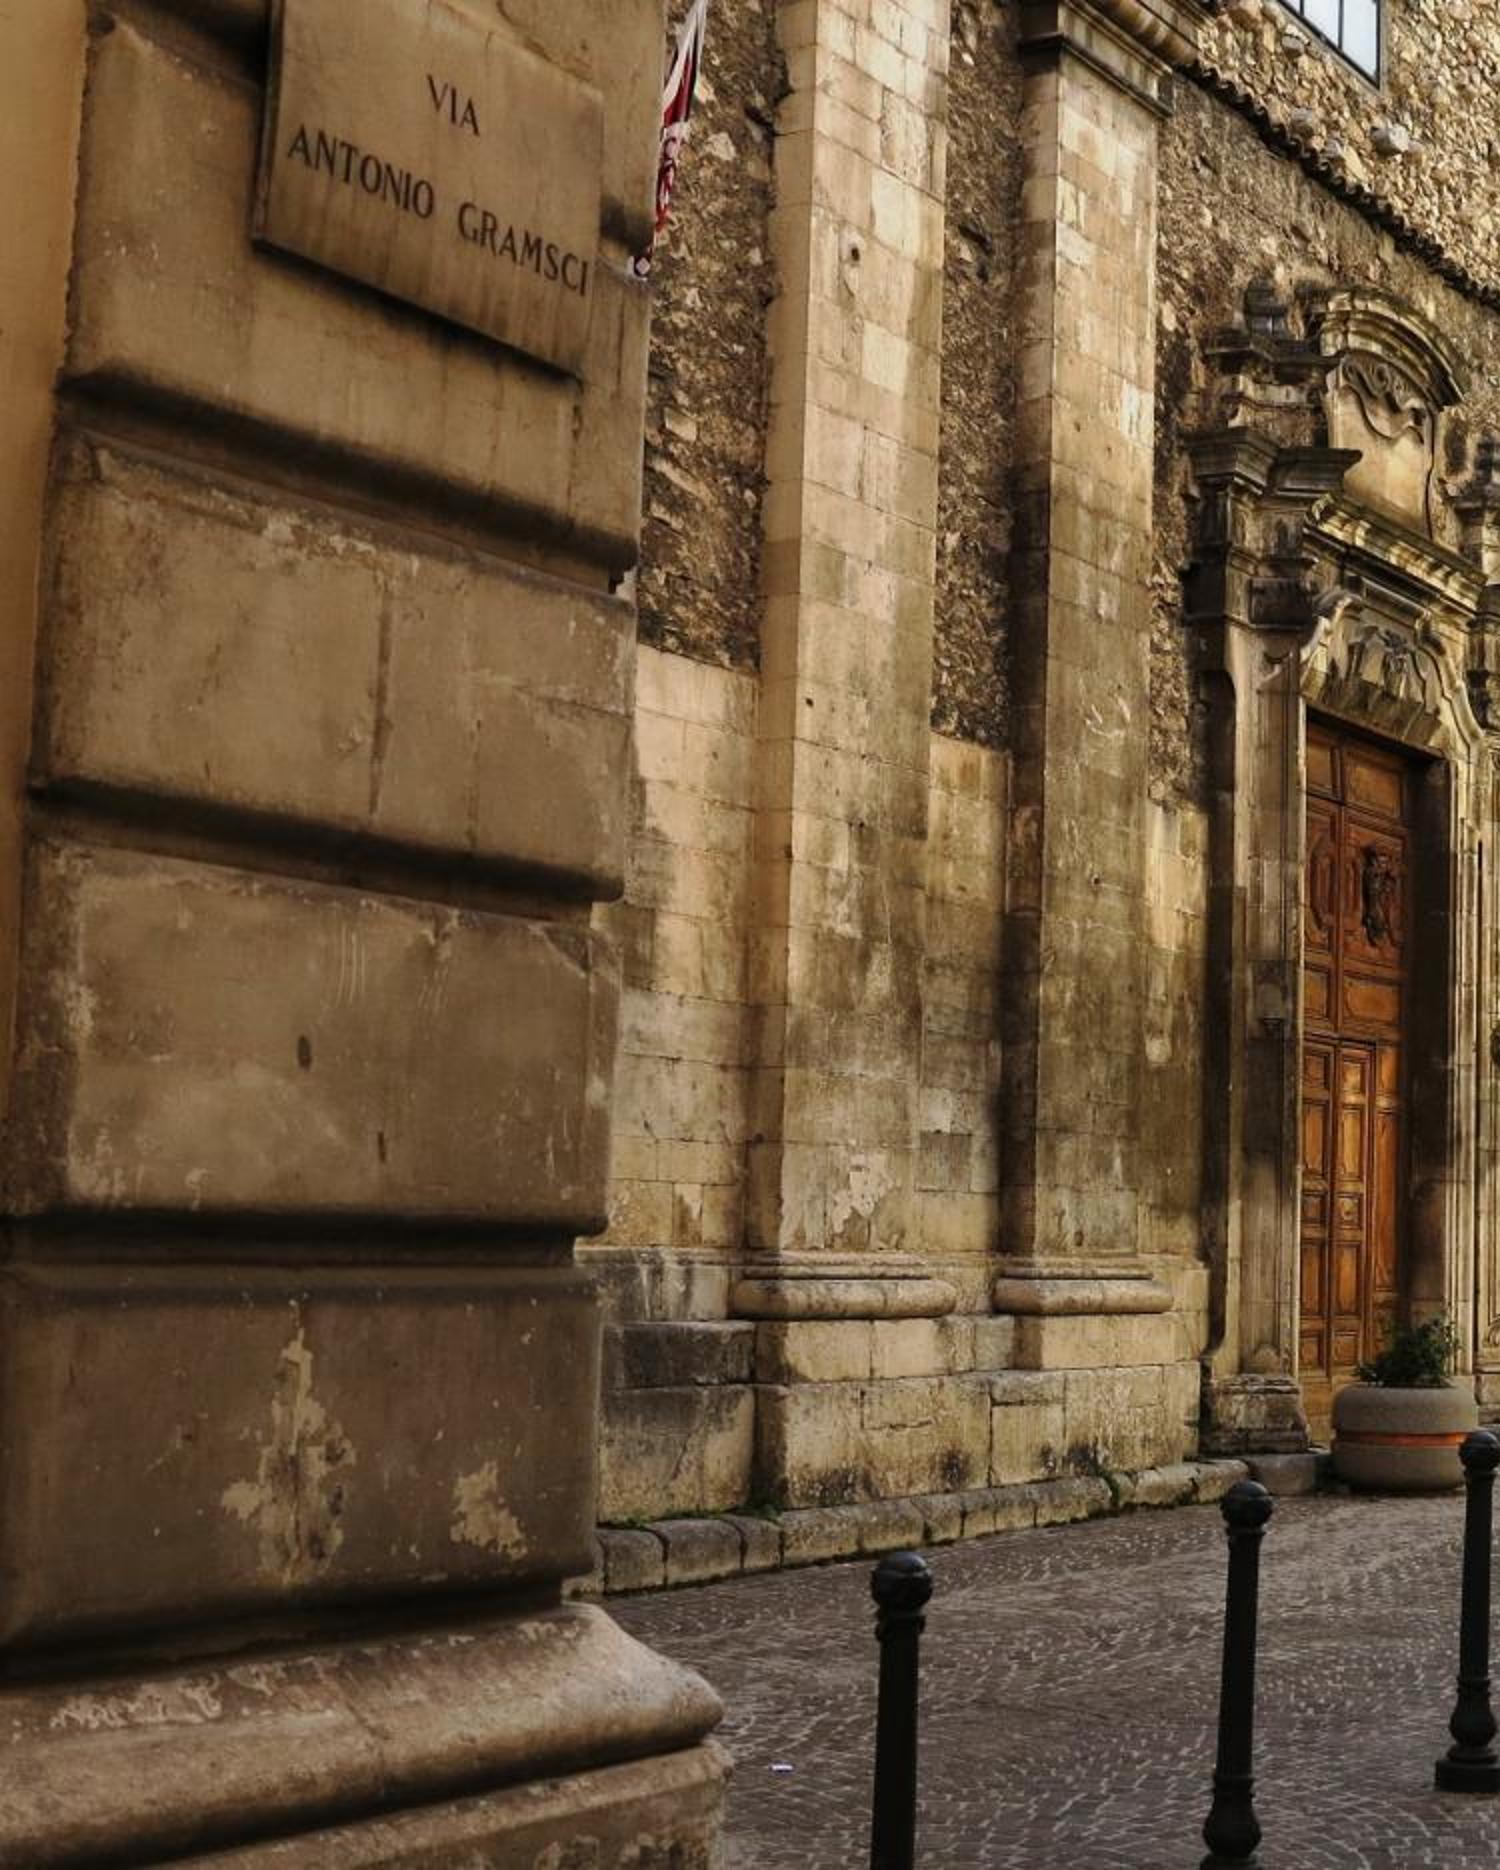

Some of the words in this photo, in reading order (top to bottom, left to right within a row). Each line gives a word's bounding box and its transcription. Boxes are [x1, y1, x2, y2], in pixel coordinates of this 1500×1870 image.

[426, 73, 480, 137] VIA
[287, 124, 435, 220] ANTONIO
[457, 202, 589, 297] GRAMSCI
